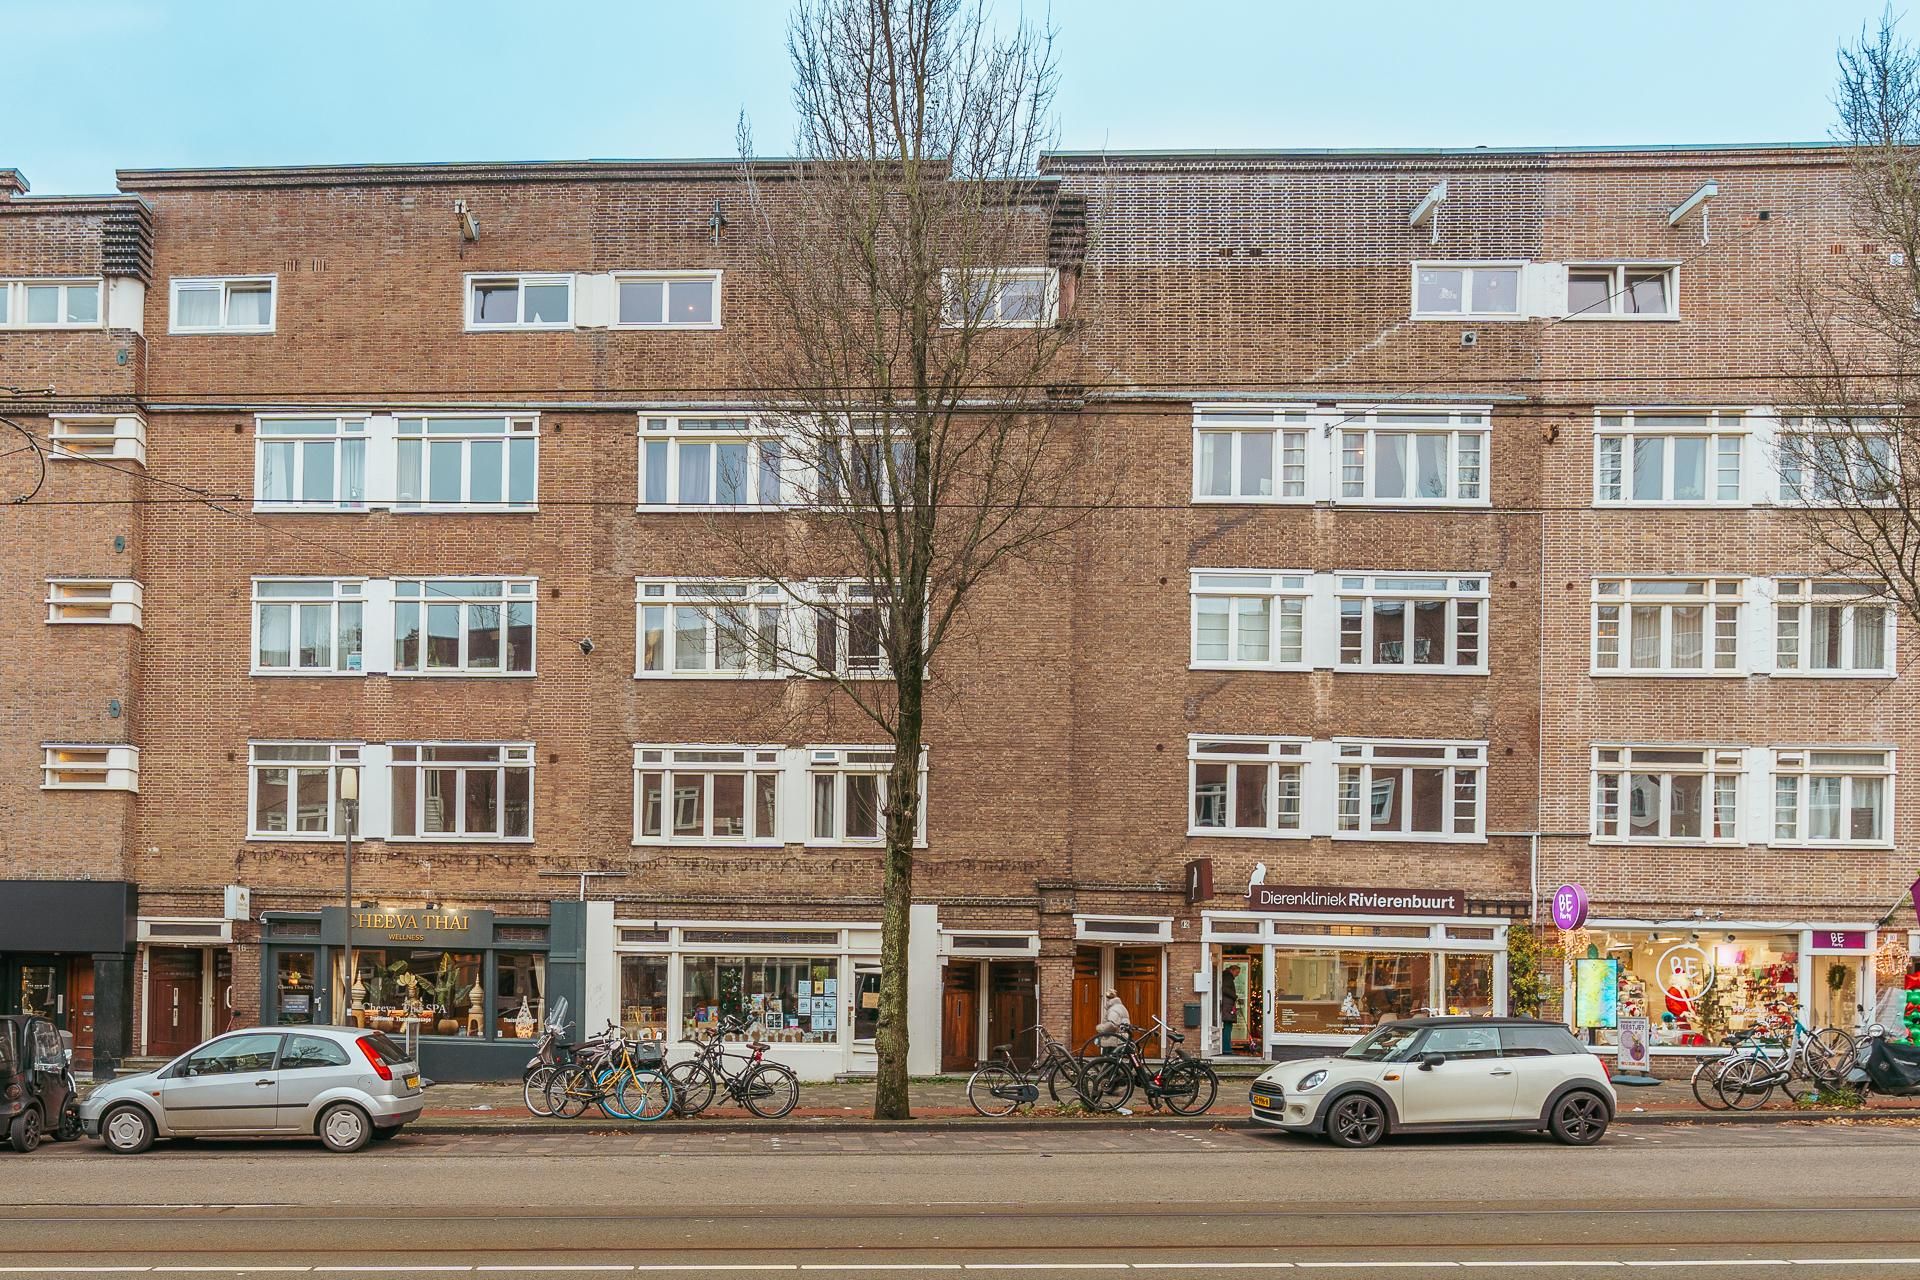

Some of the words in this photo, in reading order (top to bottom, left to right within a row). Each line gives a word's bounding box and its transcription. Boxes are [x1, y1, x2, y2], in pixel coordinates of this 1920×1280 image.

[1260, 890, 1347, 906] Dierenkliniek
[1348, 893, 1455, 909] Rivierenbuurt
[1558, 894, 1573, 912] BE
[422, 914, 470, 930] THAI
[1560, 912, 1572, 921] Party
[388, 933, 425, 941] WELLNESS
[1830, 932, 1845, 943] BE
[1670, 956, 1699, 978] BE
[362, 1002, 396, 1012] Cheeva
[426, 1004, 448, 1014] SPA
